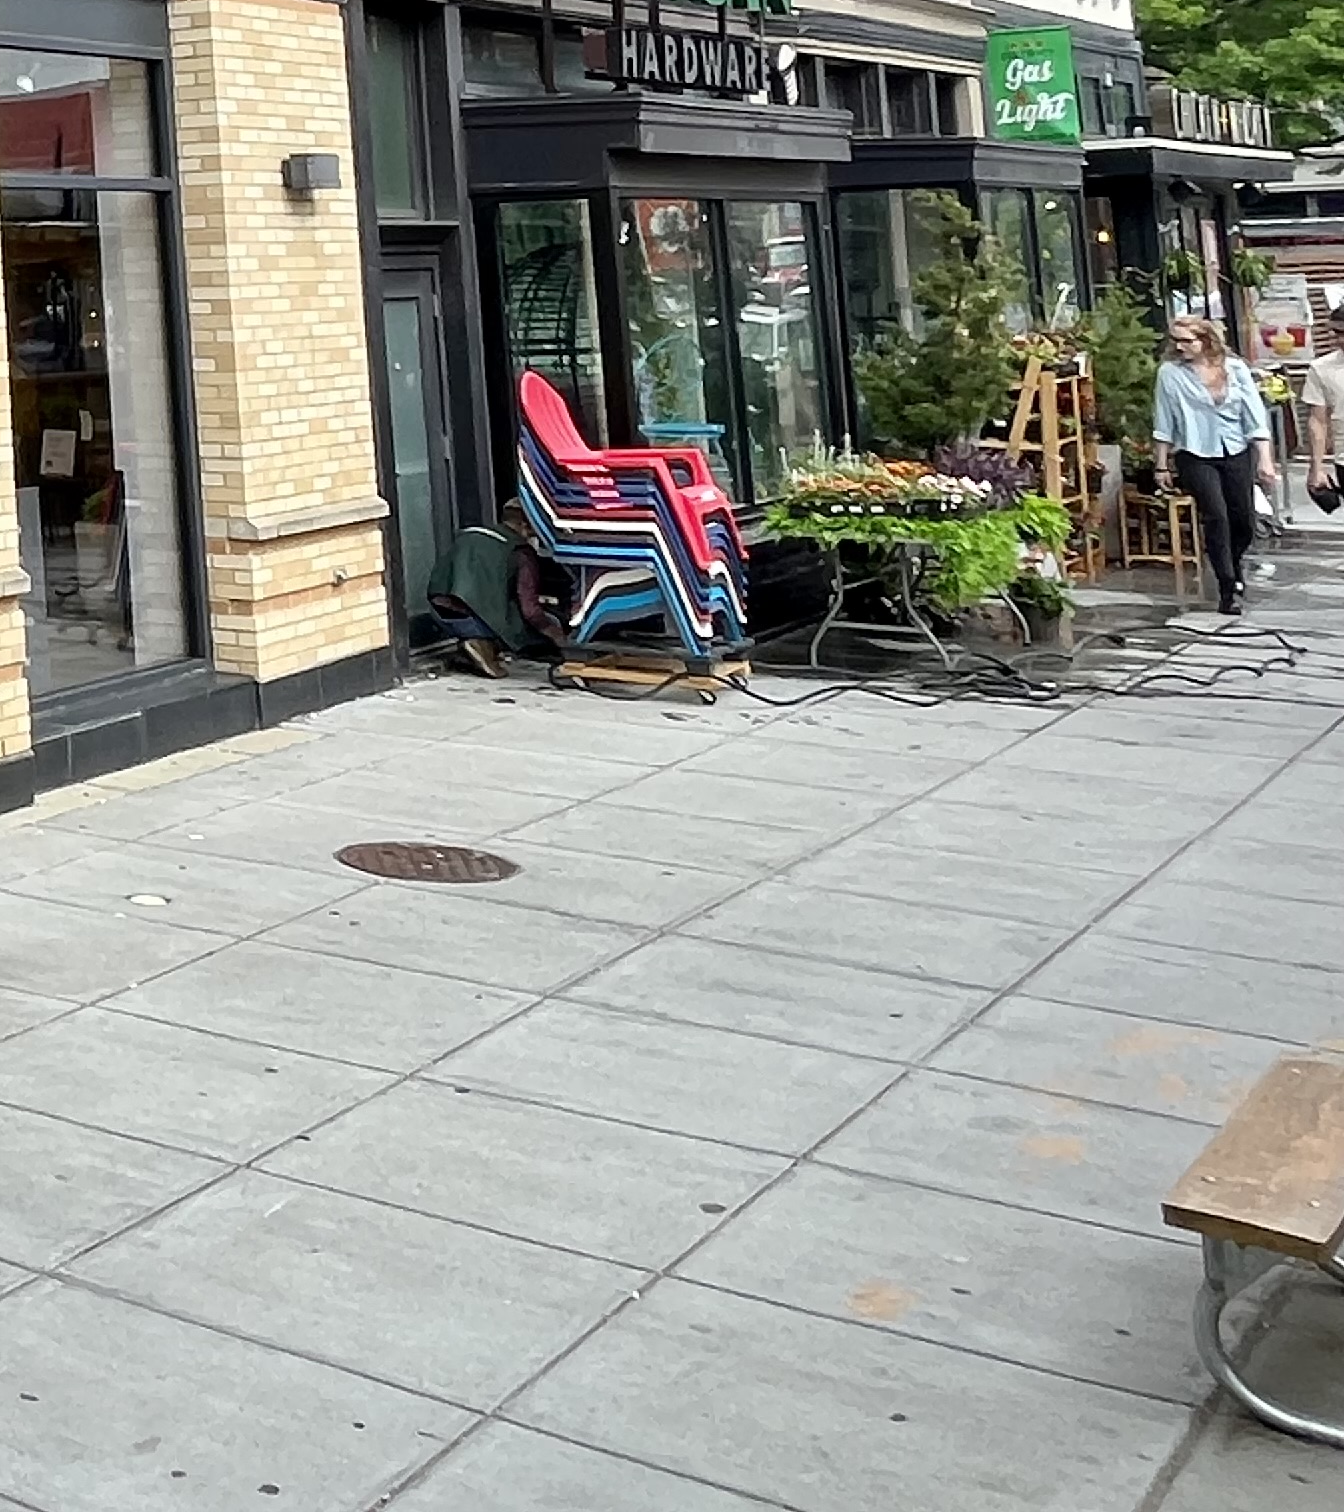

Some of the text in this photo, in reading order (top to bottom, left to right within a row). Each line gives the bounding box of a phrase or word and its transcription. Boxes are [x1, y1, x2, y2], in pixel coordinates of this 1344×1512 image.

[621, 29, 772, 93] HARDWARE
[1004, 58, 1055, 90] Gas
[995, 91, 1076, 132] Light
